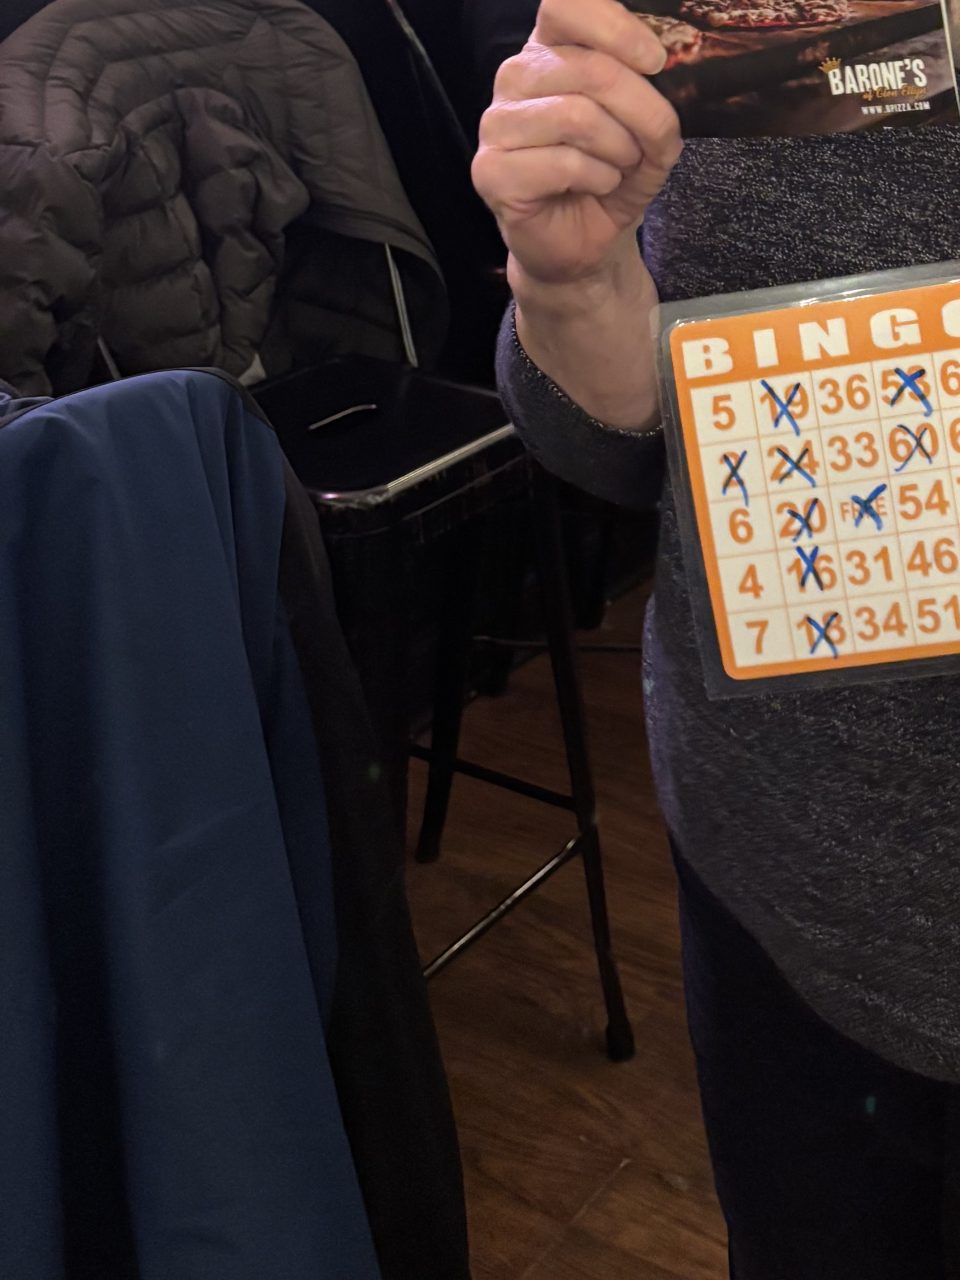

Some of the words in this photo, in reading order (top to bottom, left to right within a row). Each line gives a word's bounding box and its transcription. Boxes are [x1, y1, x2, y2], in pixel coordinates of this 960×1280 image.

[828, 58, 928, 96] BARONE'S
[711, 394, 736, 431] 5
[759, 382, 810, 422] 19
[818, 373, 872, 415] 36
[767, 439, 820, 481] 24
[827, 431, 880, 473] 33
[888, 422, 940, 464] 60
[728, 508, 755, 545] 6
[775, 498, 828, 539] 20
[898, 479, 951, 521] 54
[738, 564, 764, 599] 4
[786, 554, 838, 594] 16
[846, 546, 894, 587] 31
[906, 537, 959, 577] 46
[745, 619, 770, 655] 7
[854, 606, 908, 642] 34
